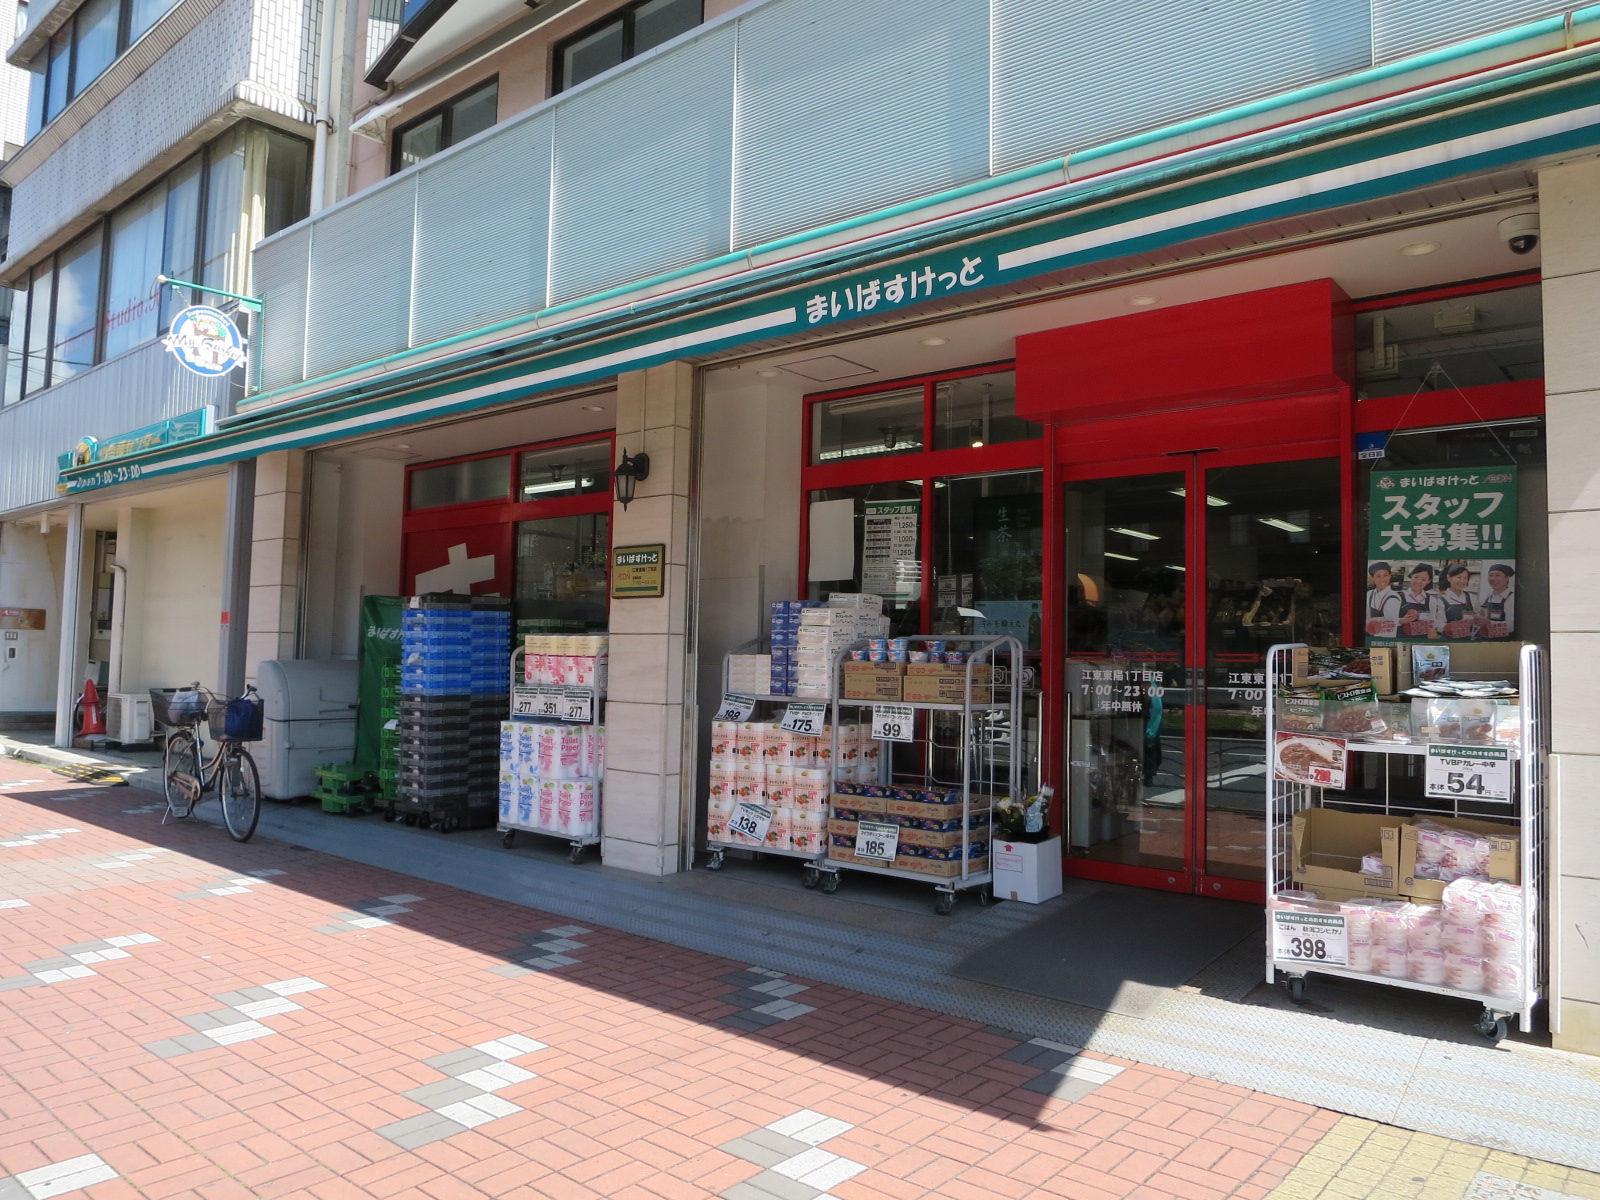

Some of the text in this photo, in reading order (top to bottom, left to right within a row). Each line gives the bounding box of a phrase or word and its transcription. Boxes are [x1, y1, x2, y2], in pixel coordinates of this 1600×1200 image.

[806, 256, 985, 324] まいばすけっと
[186, 309, 231, 327] Supermarket
[168, 334, 195, 350] My
[1399, 475, 1480, 488] まいばすけっと
[1381, 492, 1505, 520] スタッフ
[996, 506, 1012, 543] 生茶
[1379, 523, 1503, 552] 大募集!!
[617, 553, 658, 565] まいばすけっと
[1082, 669, 1164, 683] 江東東陽1丁目店
[518, 701, 531, 713] 277
[543, 702, 556, 715] 351
[569, 706, 582, 718] 277
[723, 709, 740, 720] 198
[1100, 700, 1143, 713] 年中無休
[792, 719, 813, 732] 175
[882, 722, 901, 738] 99
[561, 744, 579, 752] Paper
[1447, 772, 1485, 795] 54
[738, 816, 757, 834] 138
[865, 840, 885, 856] 185
[1290, 937, 1326, 959] 398
